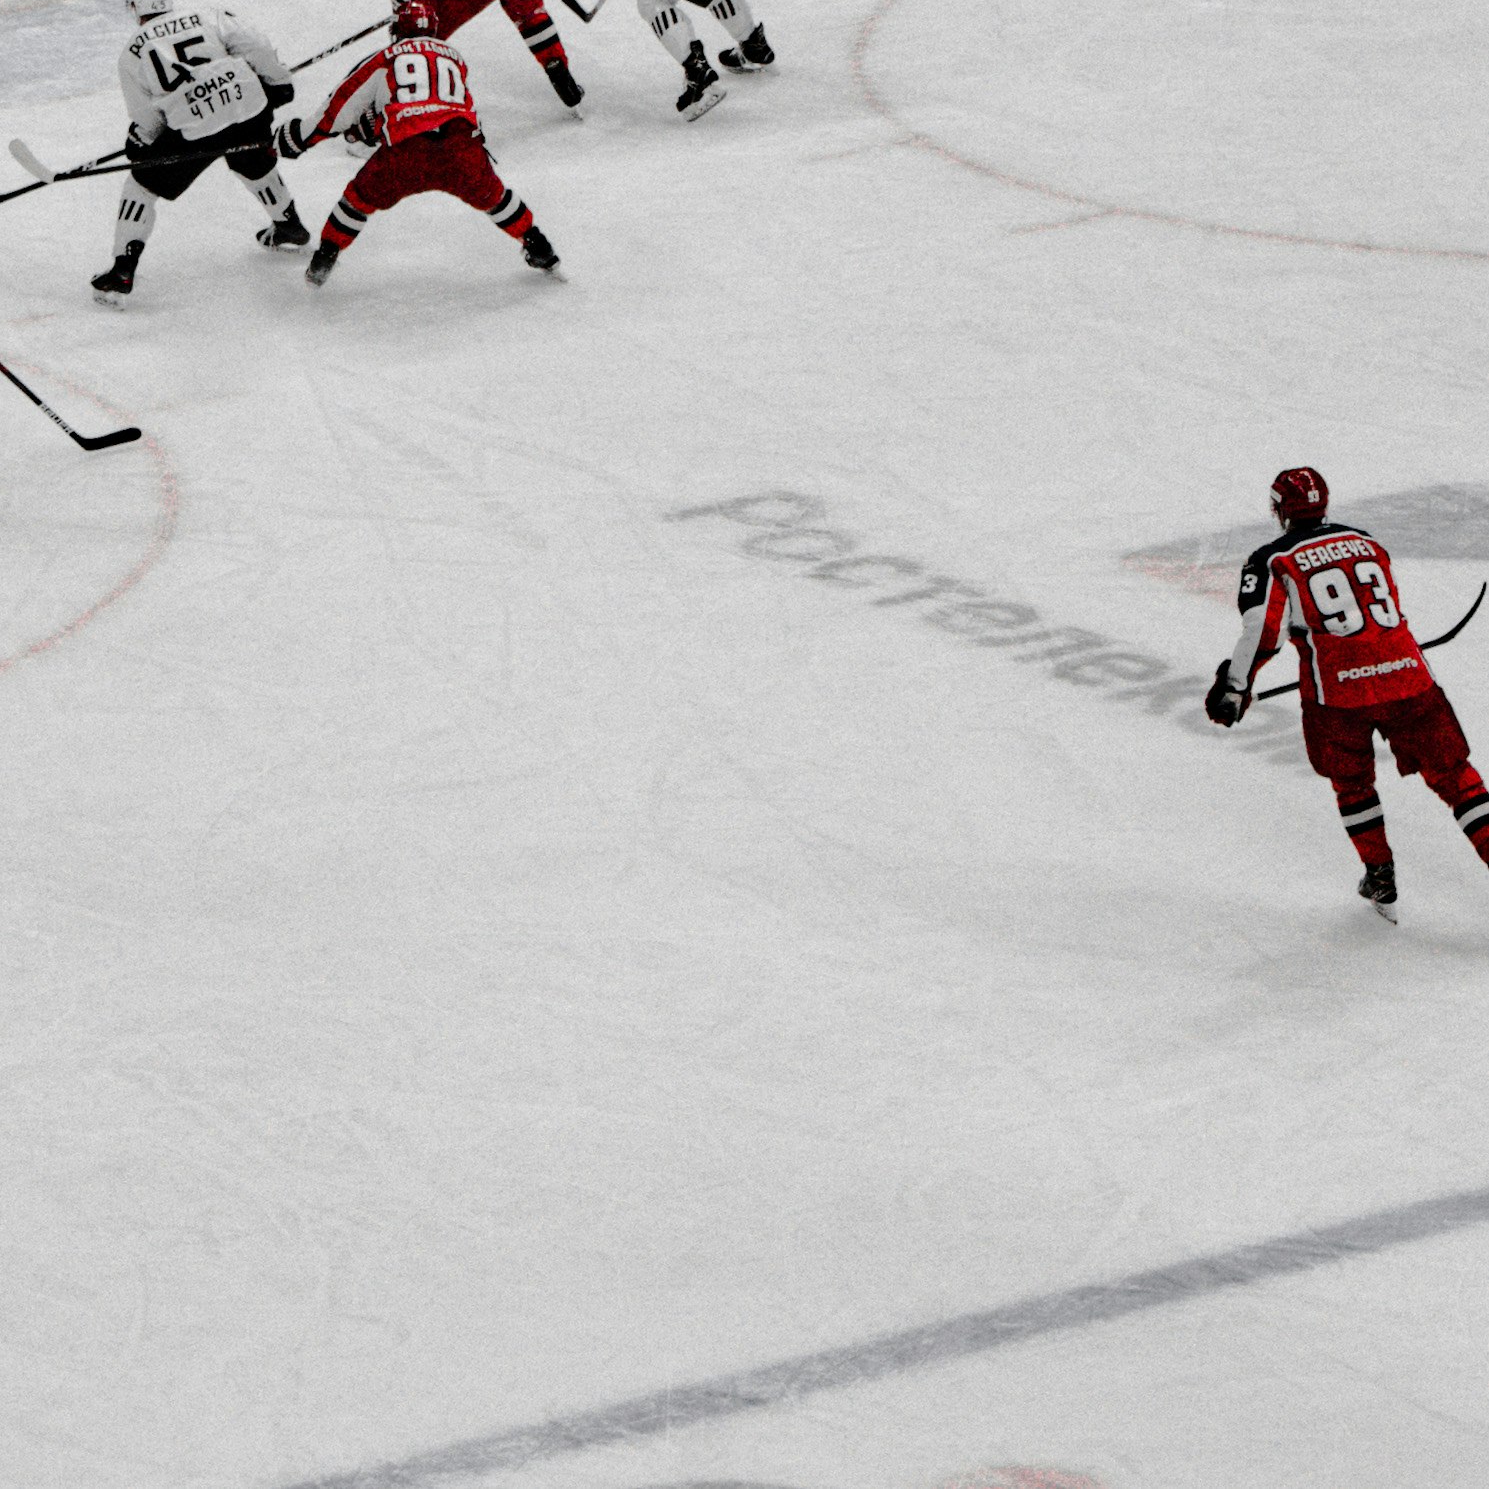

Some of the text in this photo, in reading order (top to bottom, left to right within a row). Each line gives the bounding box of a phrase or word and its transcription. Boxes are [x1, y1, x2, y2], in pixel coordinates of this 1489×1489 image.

[149, 35, 212, 92] 45
[394, 53, 466, 105] 90
[1308, 560, 1401, 638] 93
